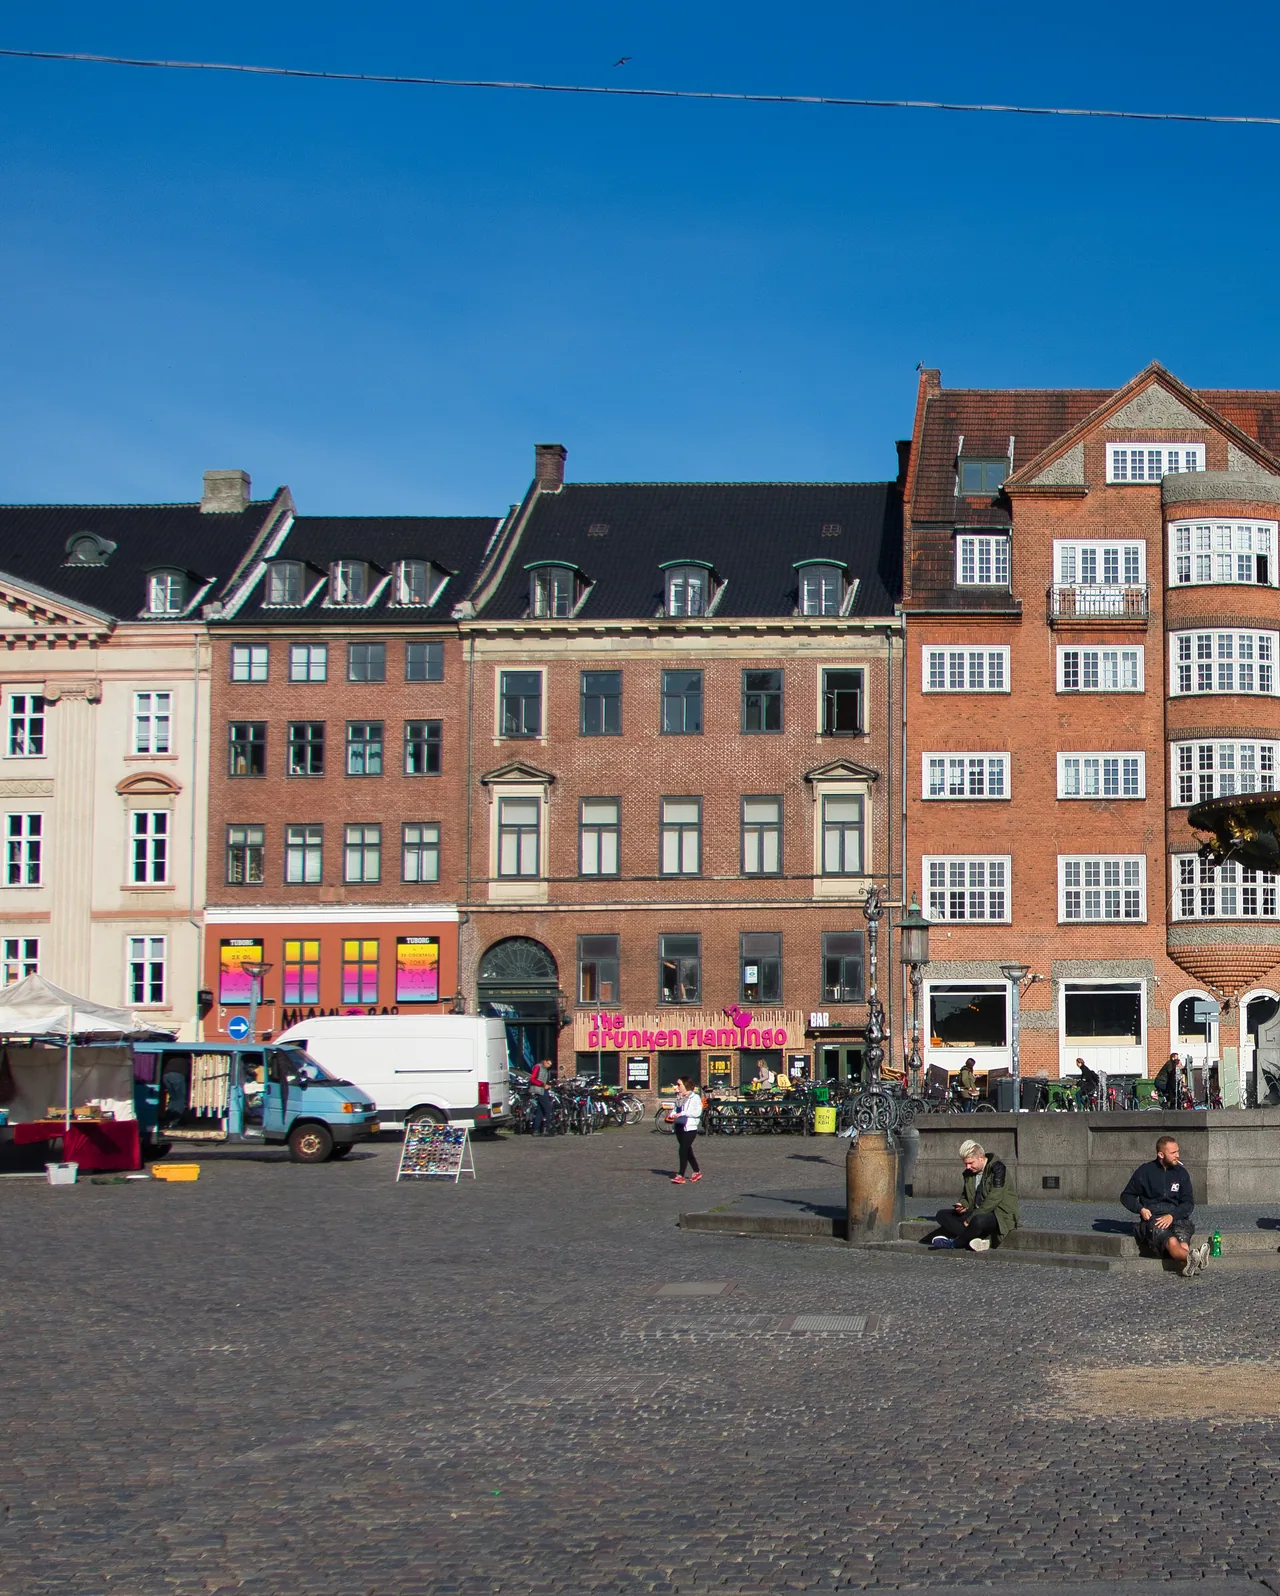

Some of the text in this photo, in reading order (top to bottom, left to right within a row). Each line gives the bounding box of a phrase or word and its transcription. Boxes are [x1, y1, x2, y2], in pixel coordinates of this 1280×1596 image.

[591, 1012, 624, 1030] The
[810, 1012, 829, 1027] BAR
[709, 1061, 730, 1070] 2 FOR 1
